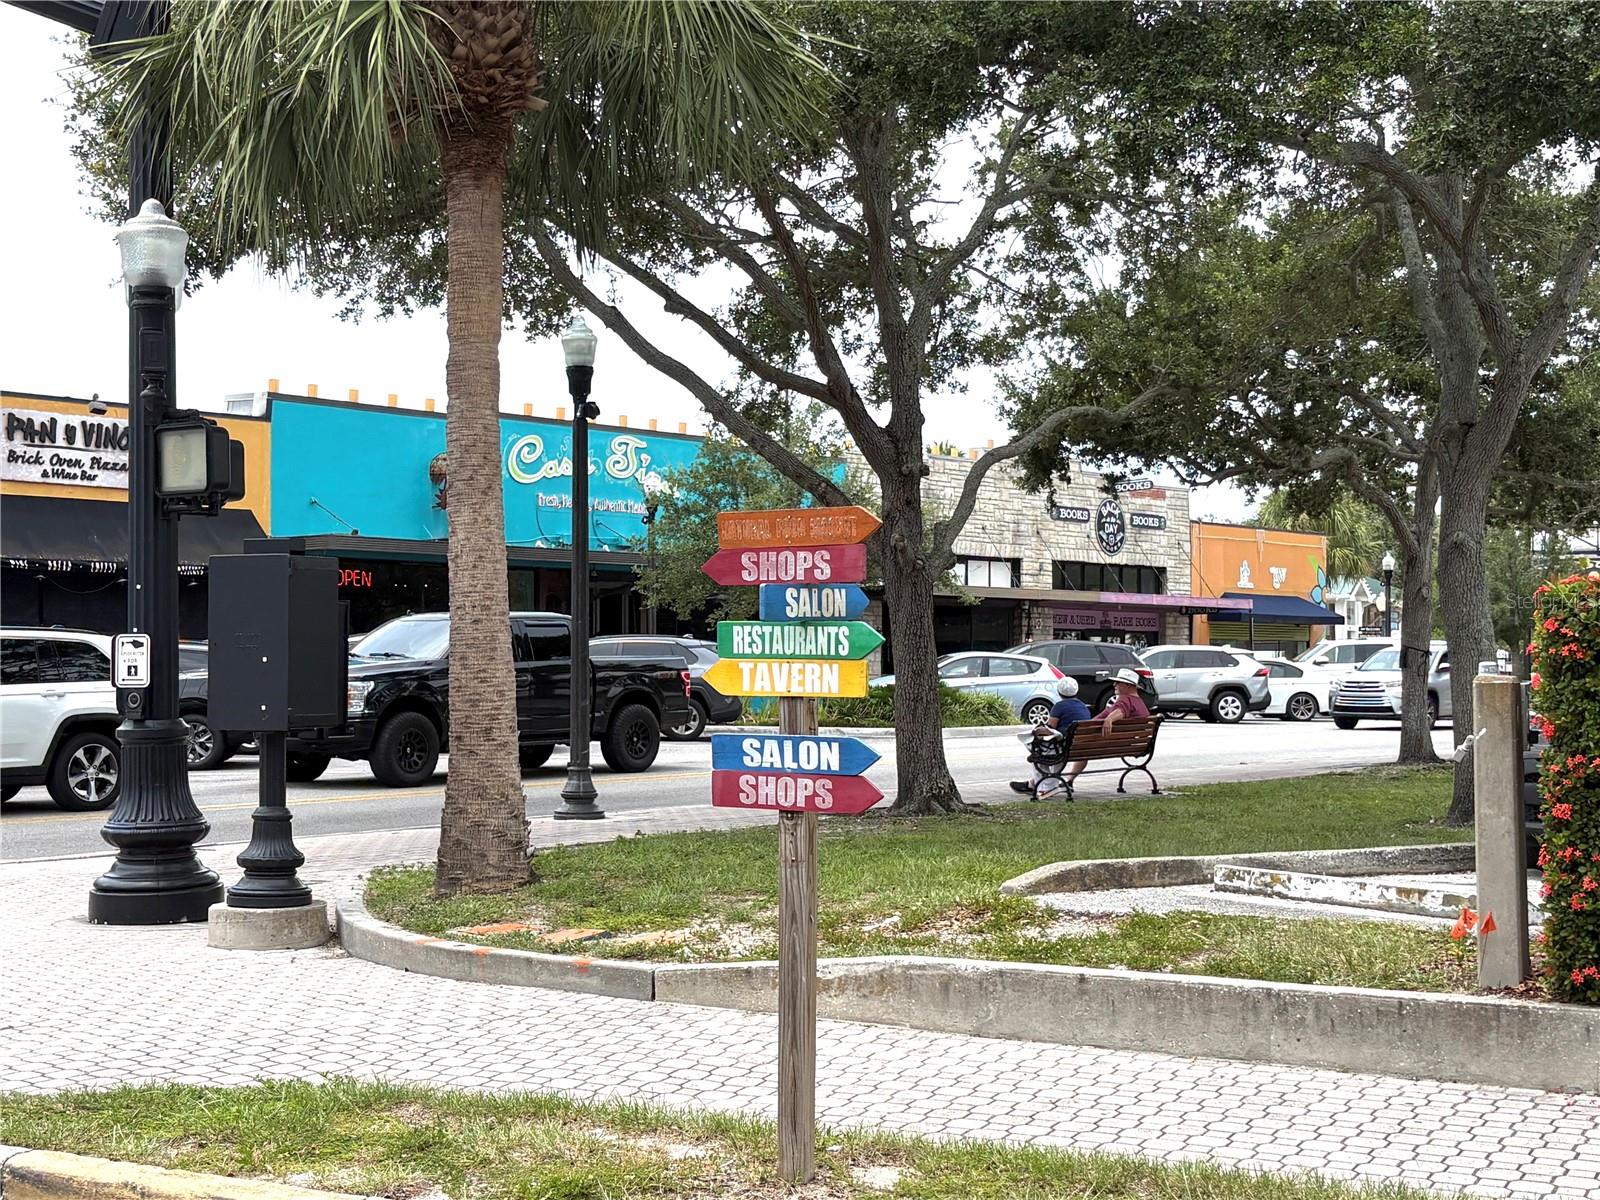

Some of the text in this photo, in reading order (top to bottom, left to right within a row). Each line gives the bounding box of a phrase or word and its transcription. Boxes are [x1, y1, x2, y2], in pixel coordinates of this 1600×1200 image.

[6, 412, 58, 443] PAN
[7, 449, 129, 472] Brick Oven Pizza
[40, 468, 98, 481] & Wine Bar
[1060, 509, 1089, 520] BOOKS
[1101, 502, 1120, 519] BACK
[1132, 516, 1160, 527] BOOKS
[1104, 523, 1118, 534] DAY
[741, 550, 832, 582] SHOPS
[785, 587, 846, 619] SALON
[732, 625, 850, 656] RESTAURANTS
[738, 662, 840, 694] TAVERN
[742, 738, 840, 771] SALON
[738, 774, 833, 809] SHOPS
